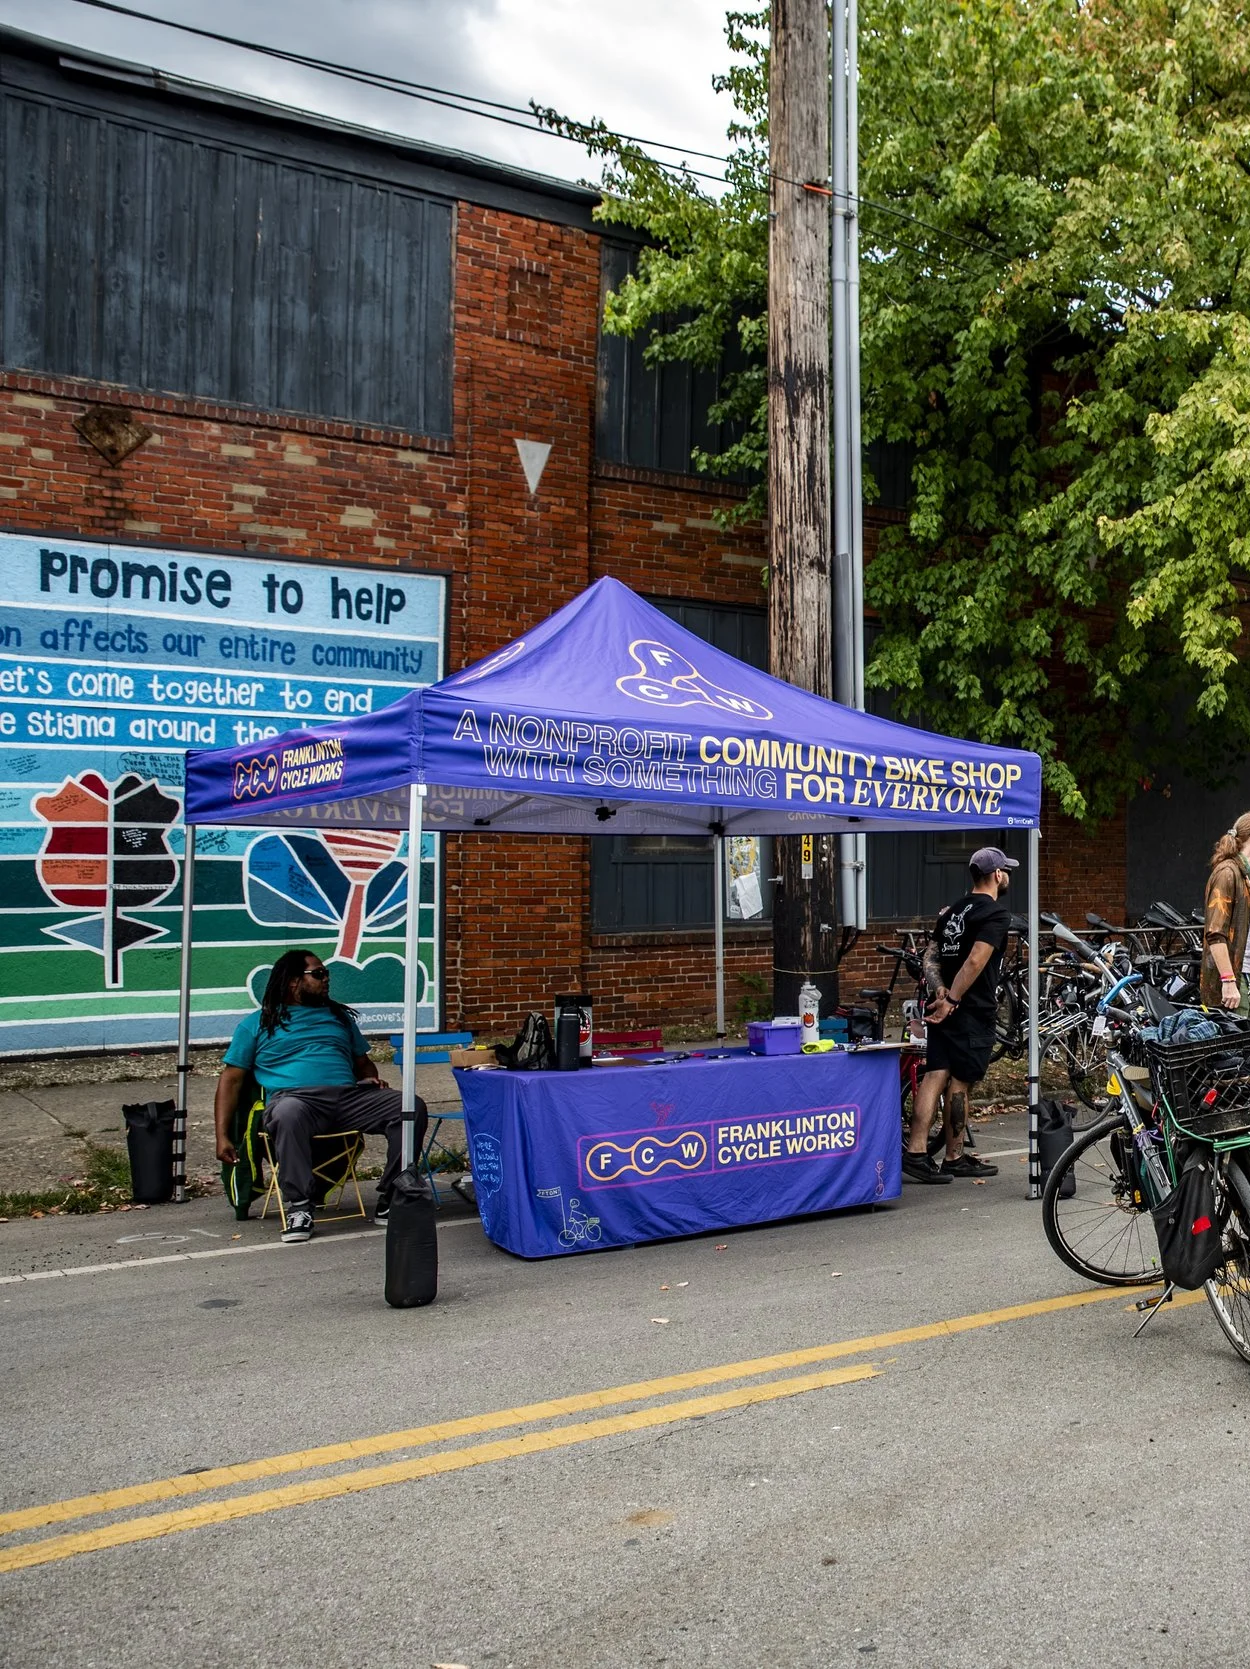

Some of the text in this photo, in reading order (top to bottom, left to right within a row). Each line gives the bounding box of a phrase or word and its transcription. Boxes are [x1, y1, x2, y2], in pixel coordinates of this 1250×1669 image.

[39, 549, 406, 624] promise to help
[40, 618, 148, 653] affects
[162, 632, 205, 656] our
[219, 633, 296, 666] entire
[312, 644, 423, 675] community
[650, 650, 672, 666] F
[68, 672, 134, 698] come
[148, 674, 264, 706] together
[280, 682, 312, 710] to
[324, 689, 372, 712] end
[639, 685, 668, 699] C
[716, 696, 754, 712] W
[28, 710, 115, 740] stigma
[130, 718, 215, 744] around
[233, 721, 278, 746] the
[282, 738, 343, 768] FRANKLINTON
[453, 710, 1021, 789] A NONPROFIT COMMUNITY BIKE SHOP
[238, 766, 275, 788] F C W
[280, 760, 343, 790] CYCLE WORKS
[484, 744, 1003, 815] WITH SOMETHING FOR EVERYONE
[718, 1112, 855, 1144] FRANKLINTON
[600, 1142, 698, 1170] F C W
[718, 1130, 855, 1165] CYCLE WORKS
